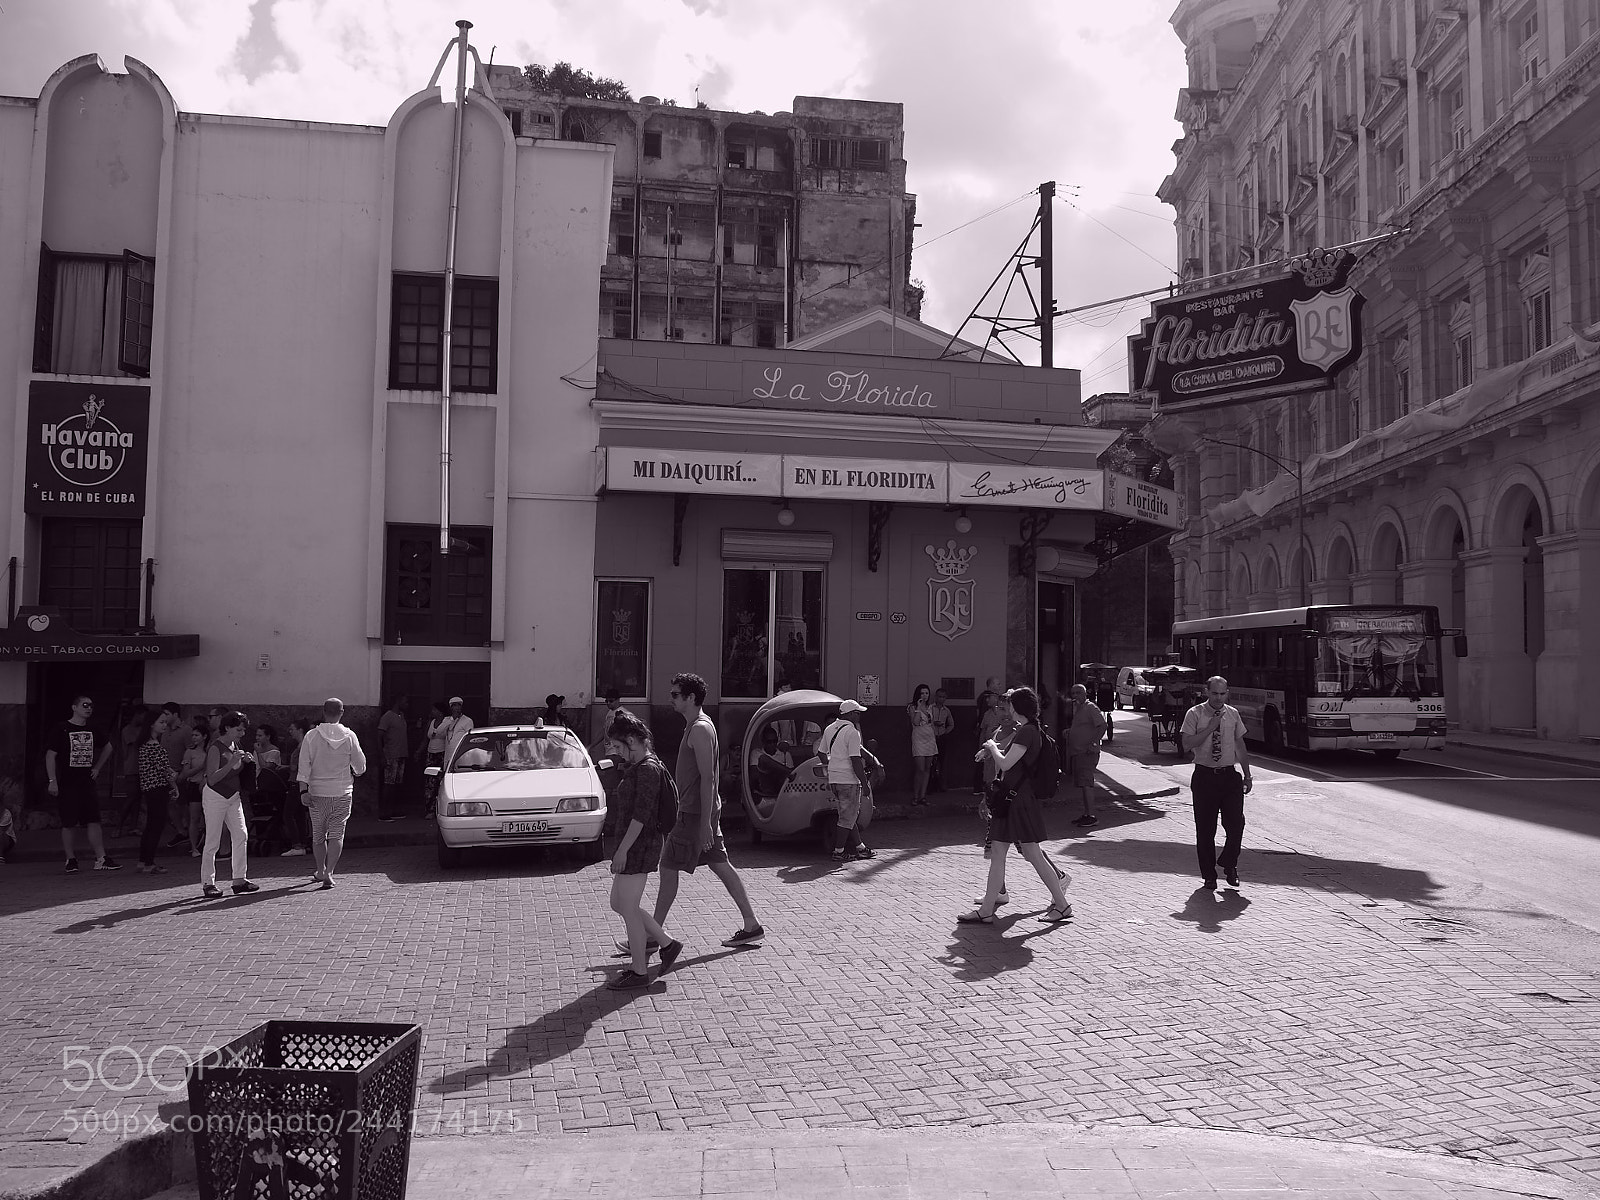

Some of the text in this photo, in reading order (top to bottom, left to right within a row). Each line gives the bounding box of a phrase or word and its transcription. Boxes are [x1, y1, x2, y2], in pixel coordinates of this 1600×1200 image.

[1185, 288, 1264, 313] RESTAURANTE
[1213, 304, 1236, 317] BAR
[1180, 361, 1276, 388] LA CUNA DEL DAIQUIRI
[752, 367, 938, 408] La Florida
[41, 423, 134, 448] Havana
[60, 448, 114, 470] Club
[633, 460, 757, 484] MI DAIQUIRÍ...
[794, 467, 936, 490] EN EL FLORIDITA
[41, 491, 136, 503] EL RON DE CUBA
[1018, 475, 1091, 503] Hemingway
[1126, 486, 1169, 516] Floridita
[13, 646, 21, 654] Y
[24, 646, 48, 655] DEL
[51, 645, 103, 655] TABACO
[106, 644, 160, 655] CUBANO
[1319, 701, 1344, 712] OM
[1417, 704, 1442, 712] 5306
[515, 823, 530, 832] 104
[532, 822, 547, 832] 649
